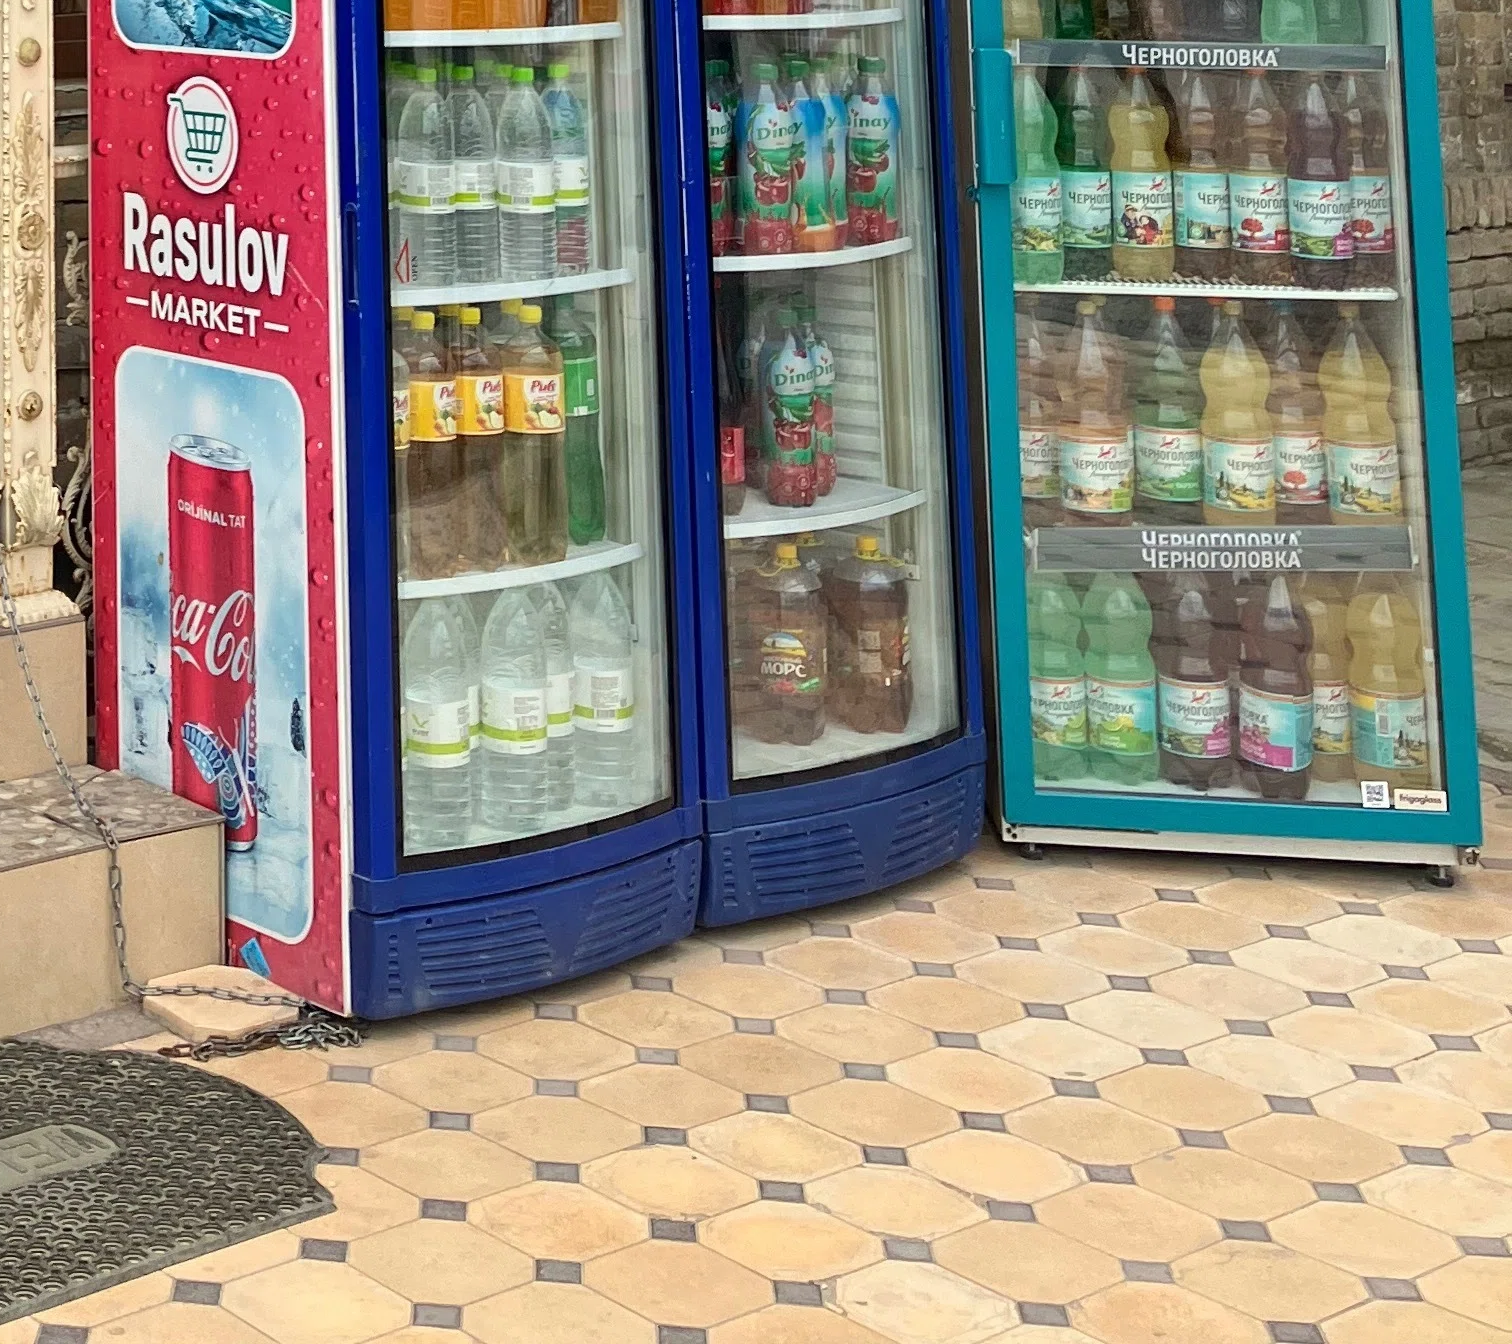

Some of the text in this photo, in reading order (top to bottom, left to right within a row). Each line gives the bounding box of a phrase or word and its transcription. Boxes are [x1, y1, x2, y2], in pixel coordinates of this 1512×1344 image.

[123, 191, 289, 297] Rasulov
[150, 289, 262, 338] MARKET
[228, 514, 247, 529] TAT
